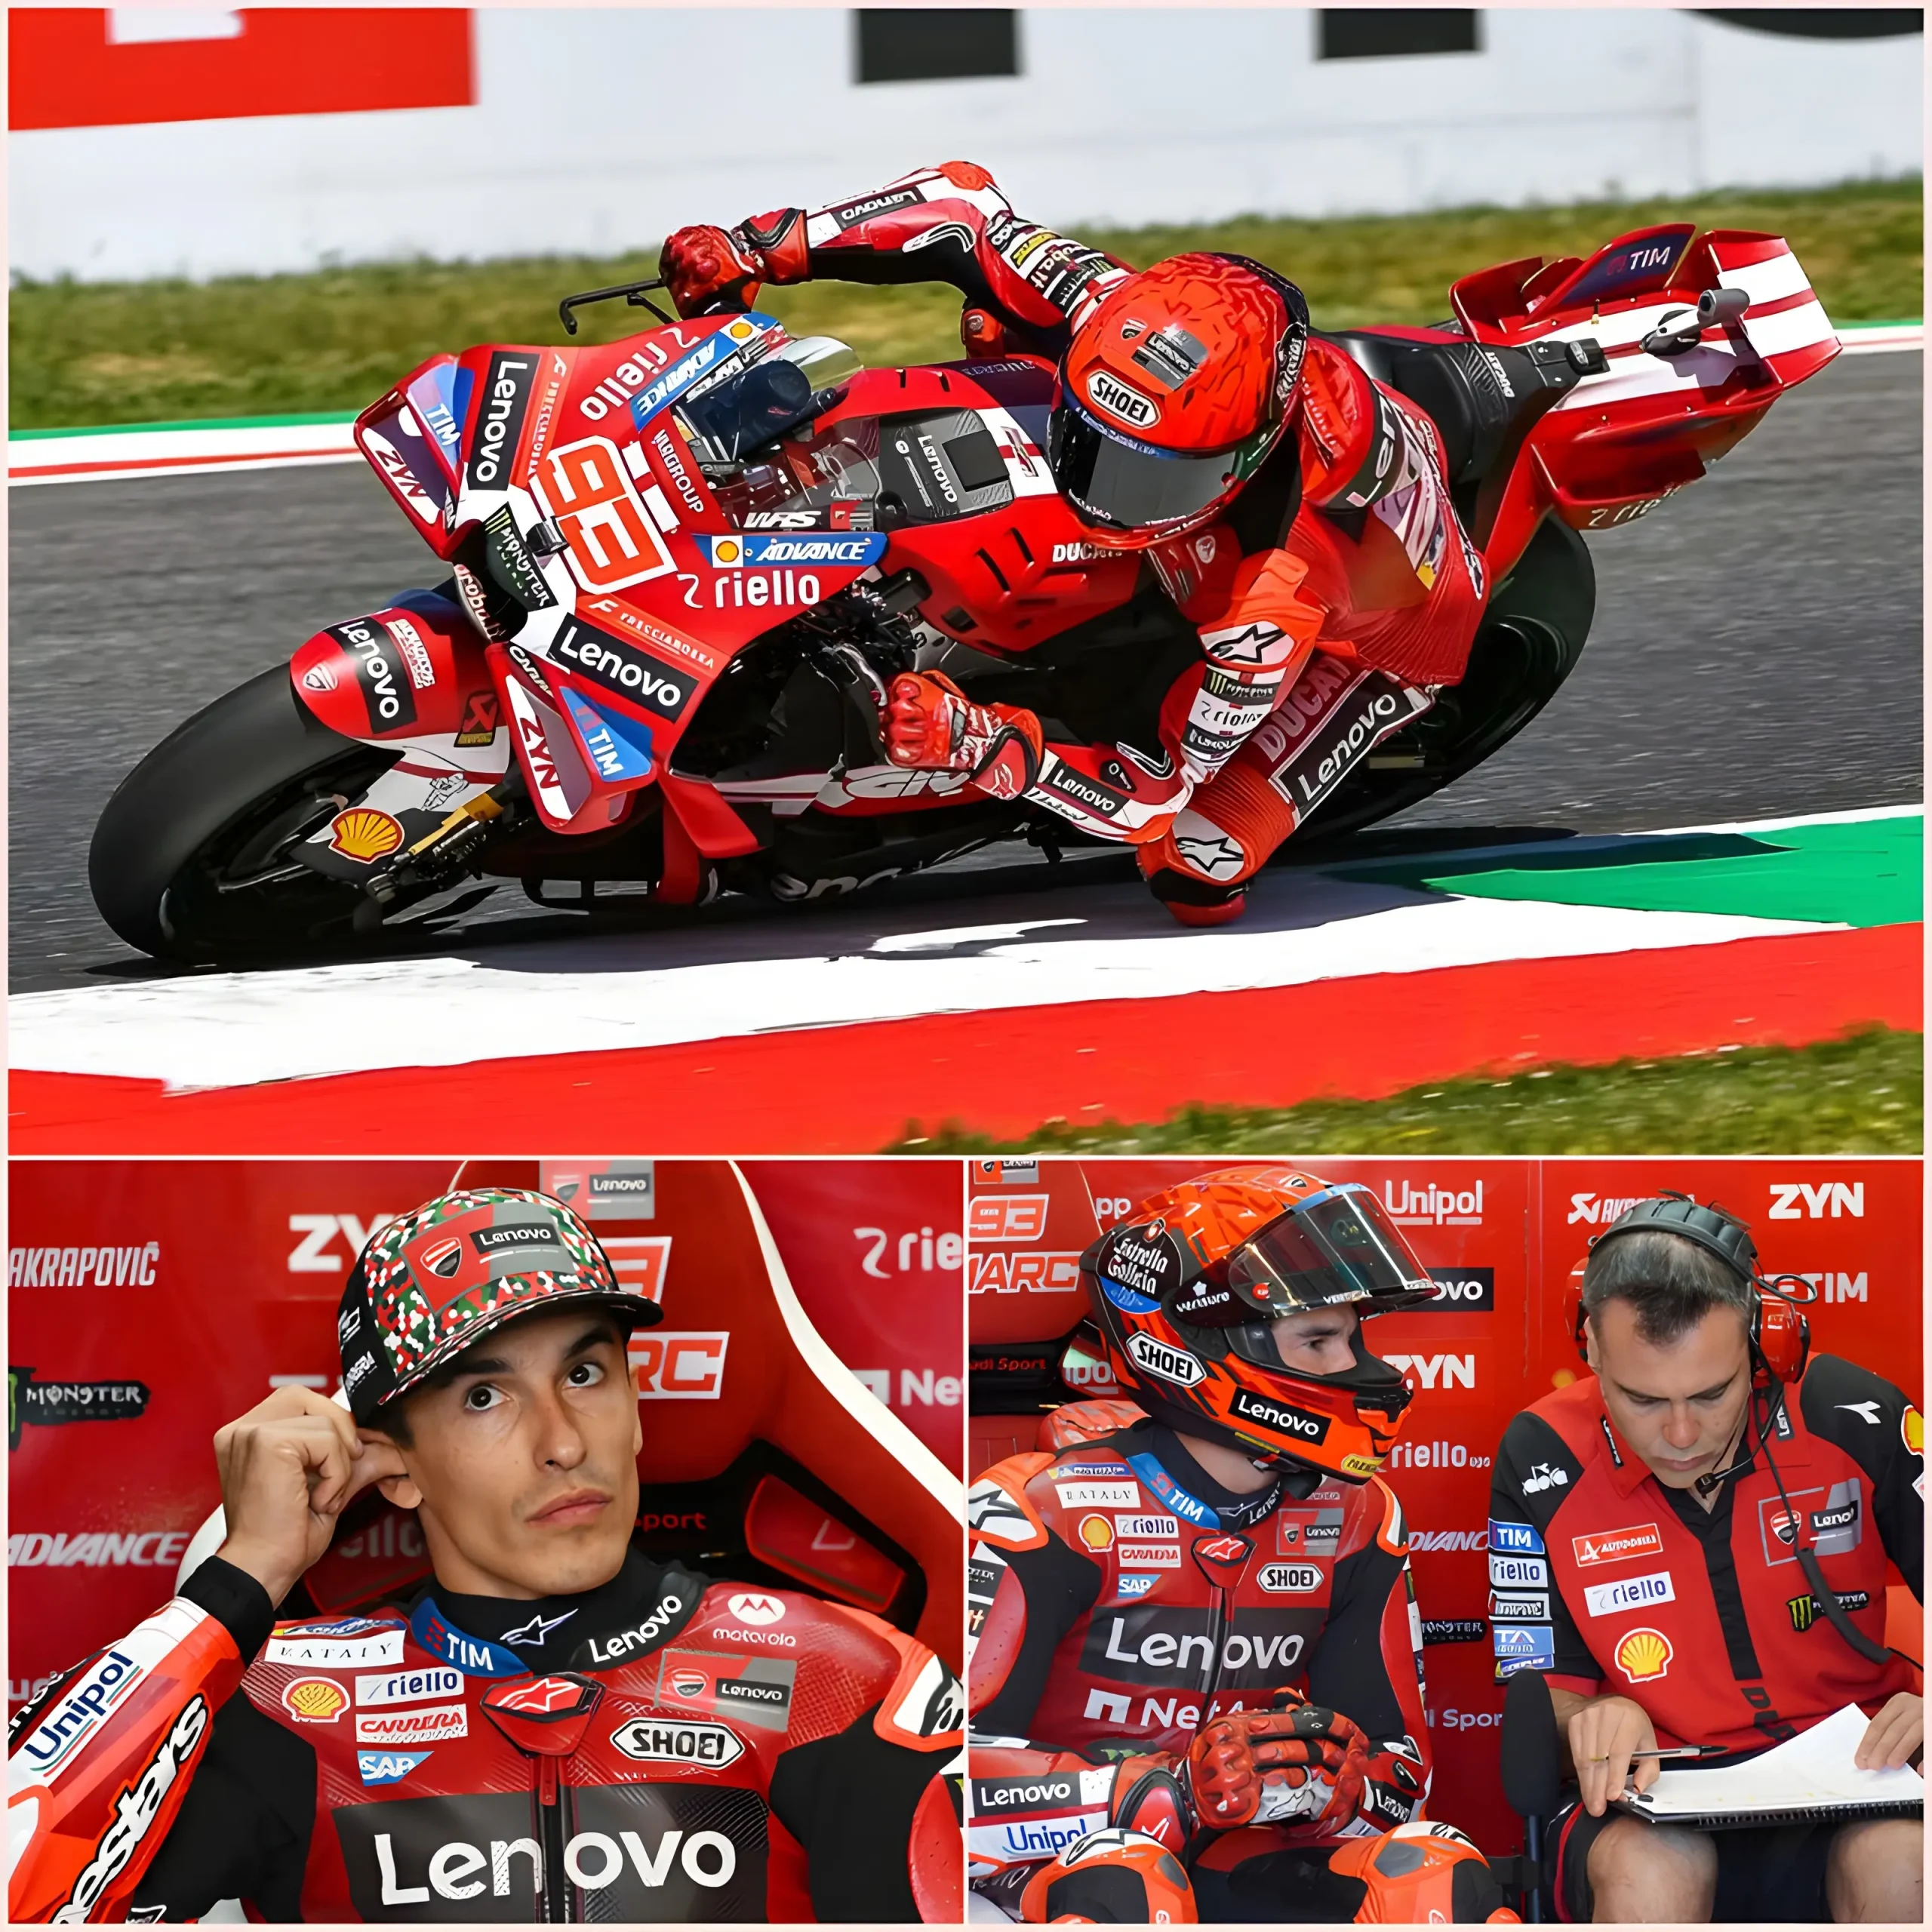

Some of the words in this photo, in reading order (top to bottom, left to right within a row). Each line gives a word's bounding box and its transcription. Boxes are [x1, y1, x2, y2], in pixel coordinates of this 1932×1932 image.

[1630, 246, 1671, 270] TIM
[580, 342, 669, 420] riello
[1093, 377, 1150, 423] SHOEI
[423, 404, 460, 446] TIM
[475, 360, 528, 482] Lenovo
[374, 448, 429, 499] ZYN
[537, 439, 671, 590] 93
[755, 540, 867, 561] ADVANCE
[714, 569, 820, 608] riello
[338, 619, 399, 719] Lenovo
[559, 626, 682, 707] Lenovo
[520, 716, 562, 789] ZYN
[587, 728, 625, 777] TIM
[1300, 694, 1396, 802] Lenovo
[969, 1196, 1048, 1239] 93
[1385, 1179, 1483, 1225] Unipol
[1768, 1182, 1866, 1220] ZYN
[479, 1227, 552, 1247] Lenovo
[898, 1226, 964, 1272] rie
[1432, 1281, 1484, 1301] ovo
[1137, 1340, 1194, 1381] SHOEI
[1236, 1394, 1320, 1436] Lenovo
[1391, 1440, 1468, 1469] riello
[633, 1512, 707, 1533] port
[1169, 1487, 1204, 1521] TIM
[1408, 1531, 1490, 1552] DVANC
[1497, 1528, 1532, 1547] TIM
[1612, 1580, 1667, 1605] riello
[587, 1594, 683, 1664] Lenovo
[1105, 1617, 1305, 1672] Lenovo
[446, 1632, 494, 1671] TIM
[387, 1671, 458, 1697] riello
[720, 1681, 783, 1702] Lenovo
[24, 1651, 134, 1761] Unipol
[1442, 1709, 1503, 1731] Spor
[631, 1728, 727, 1761] SHOEI
[980, 1782, 1072, 1807] Lenovo
[1006, 1819, 1088, 1855] Unipol
[374, 1830, 737, 1906] Lenovo
